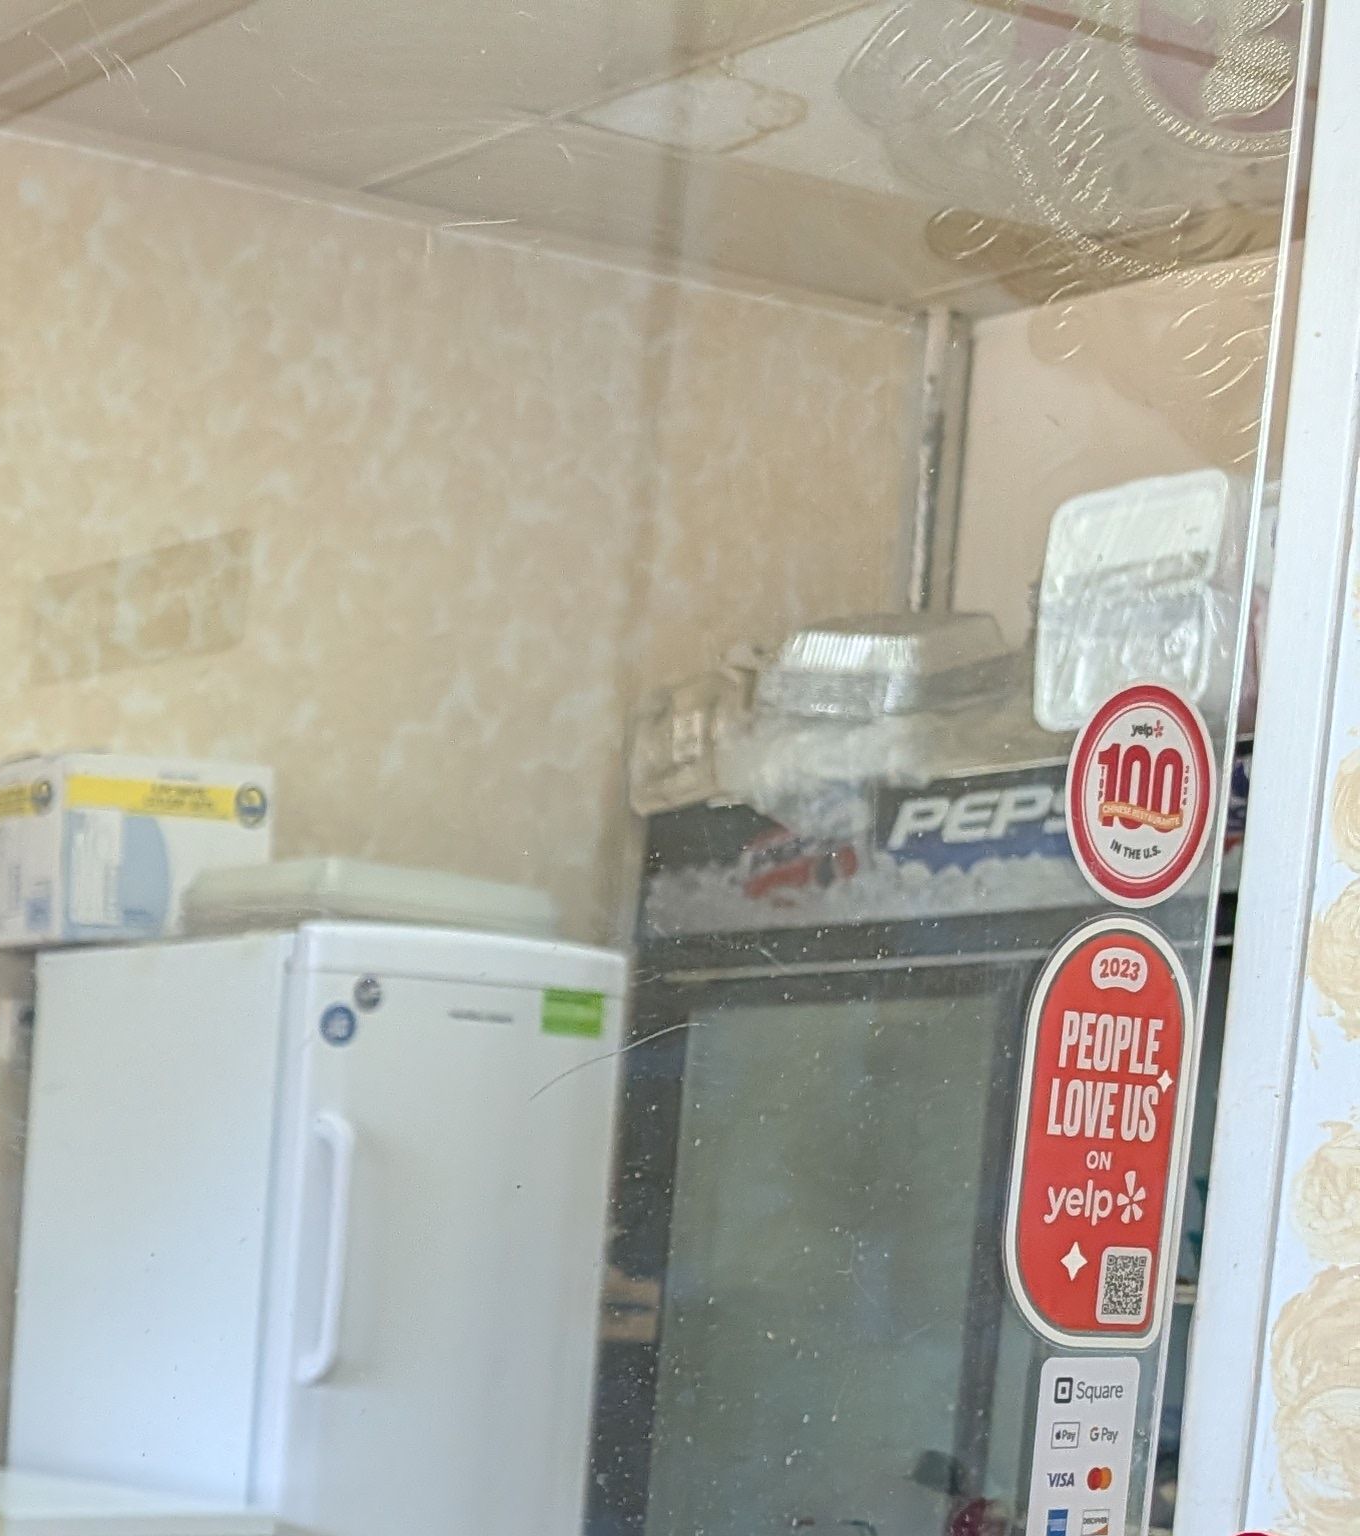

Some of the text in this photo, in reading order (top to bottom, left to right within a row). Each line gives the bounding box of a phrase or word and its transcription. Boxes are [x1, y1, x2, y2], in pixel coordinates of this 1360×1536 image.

[1130, 723, 1153, 739] yelp
[1098, 743, 1183, 833] 100
[1110, 838, 1123, 855] IN
[1123, 846, 1142, 861] THE
[1099, 957, 1141, 981] 2023
[1058, 1010, 1164, 1076] PEOPLE
[1047, 1077, 1160, 1142] LOVE US
[1086, 1150, 1112, 1171] ON
[1043, 1179, 1113, 1227] yelp
[1076, 1381, 1124, 1403] Square
[1101, 1427, 1119, 1444] Pay
[1047, 1472, 1075, 1488] VISA
